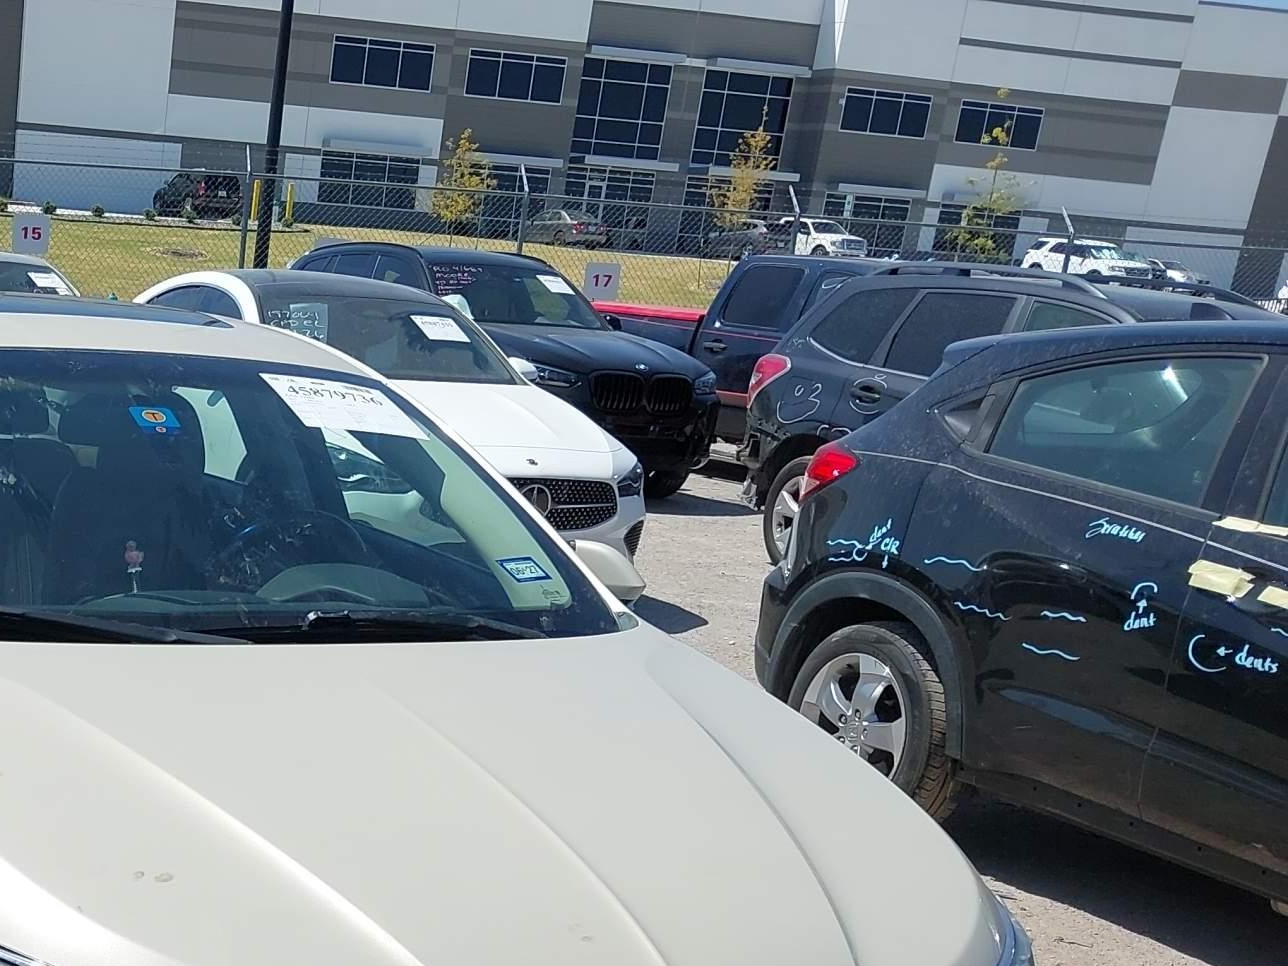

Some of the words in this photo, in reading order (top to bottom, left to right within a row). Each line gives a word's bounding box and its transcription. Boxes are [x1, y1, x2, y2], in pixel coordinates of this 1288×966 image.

[21, 226, 42, 241] 15
[593, 274, 612, 288] 17
[287, 385, 384, 407] 45879736
[1123, 611, 1157, 631] dent
[1235, 643, 1279, 674] dents
